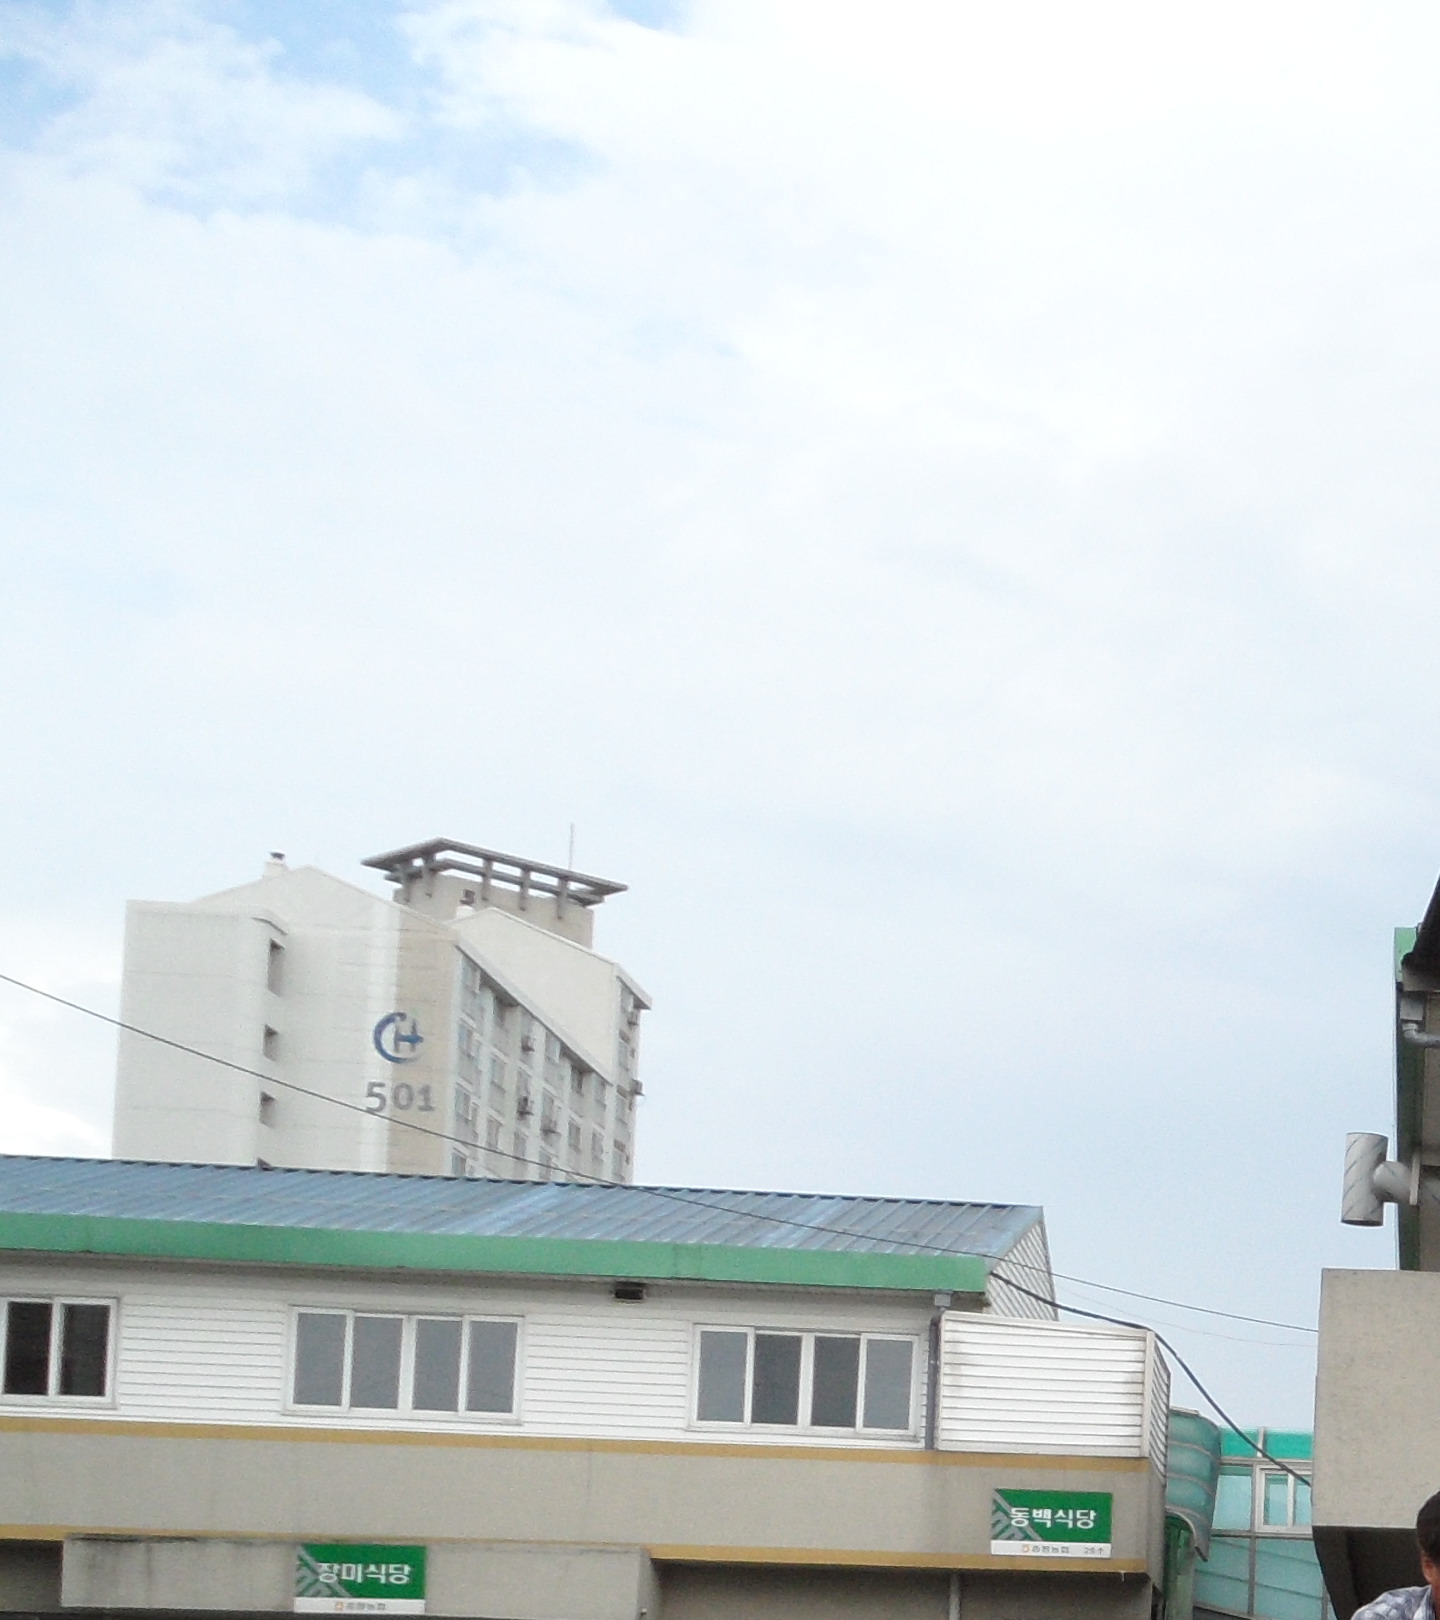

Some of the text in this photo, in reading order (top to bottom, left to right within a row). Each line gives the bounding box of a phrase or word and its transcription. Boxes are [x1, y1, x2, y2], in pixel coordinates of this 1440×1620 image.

[364, 1081, 436, 1113] 501
[1010, 1507, 1097, 1529] 동백식당
[317, 1562, 411, 1584] 장미식당
